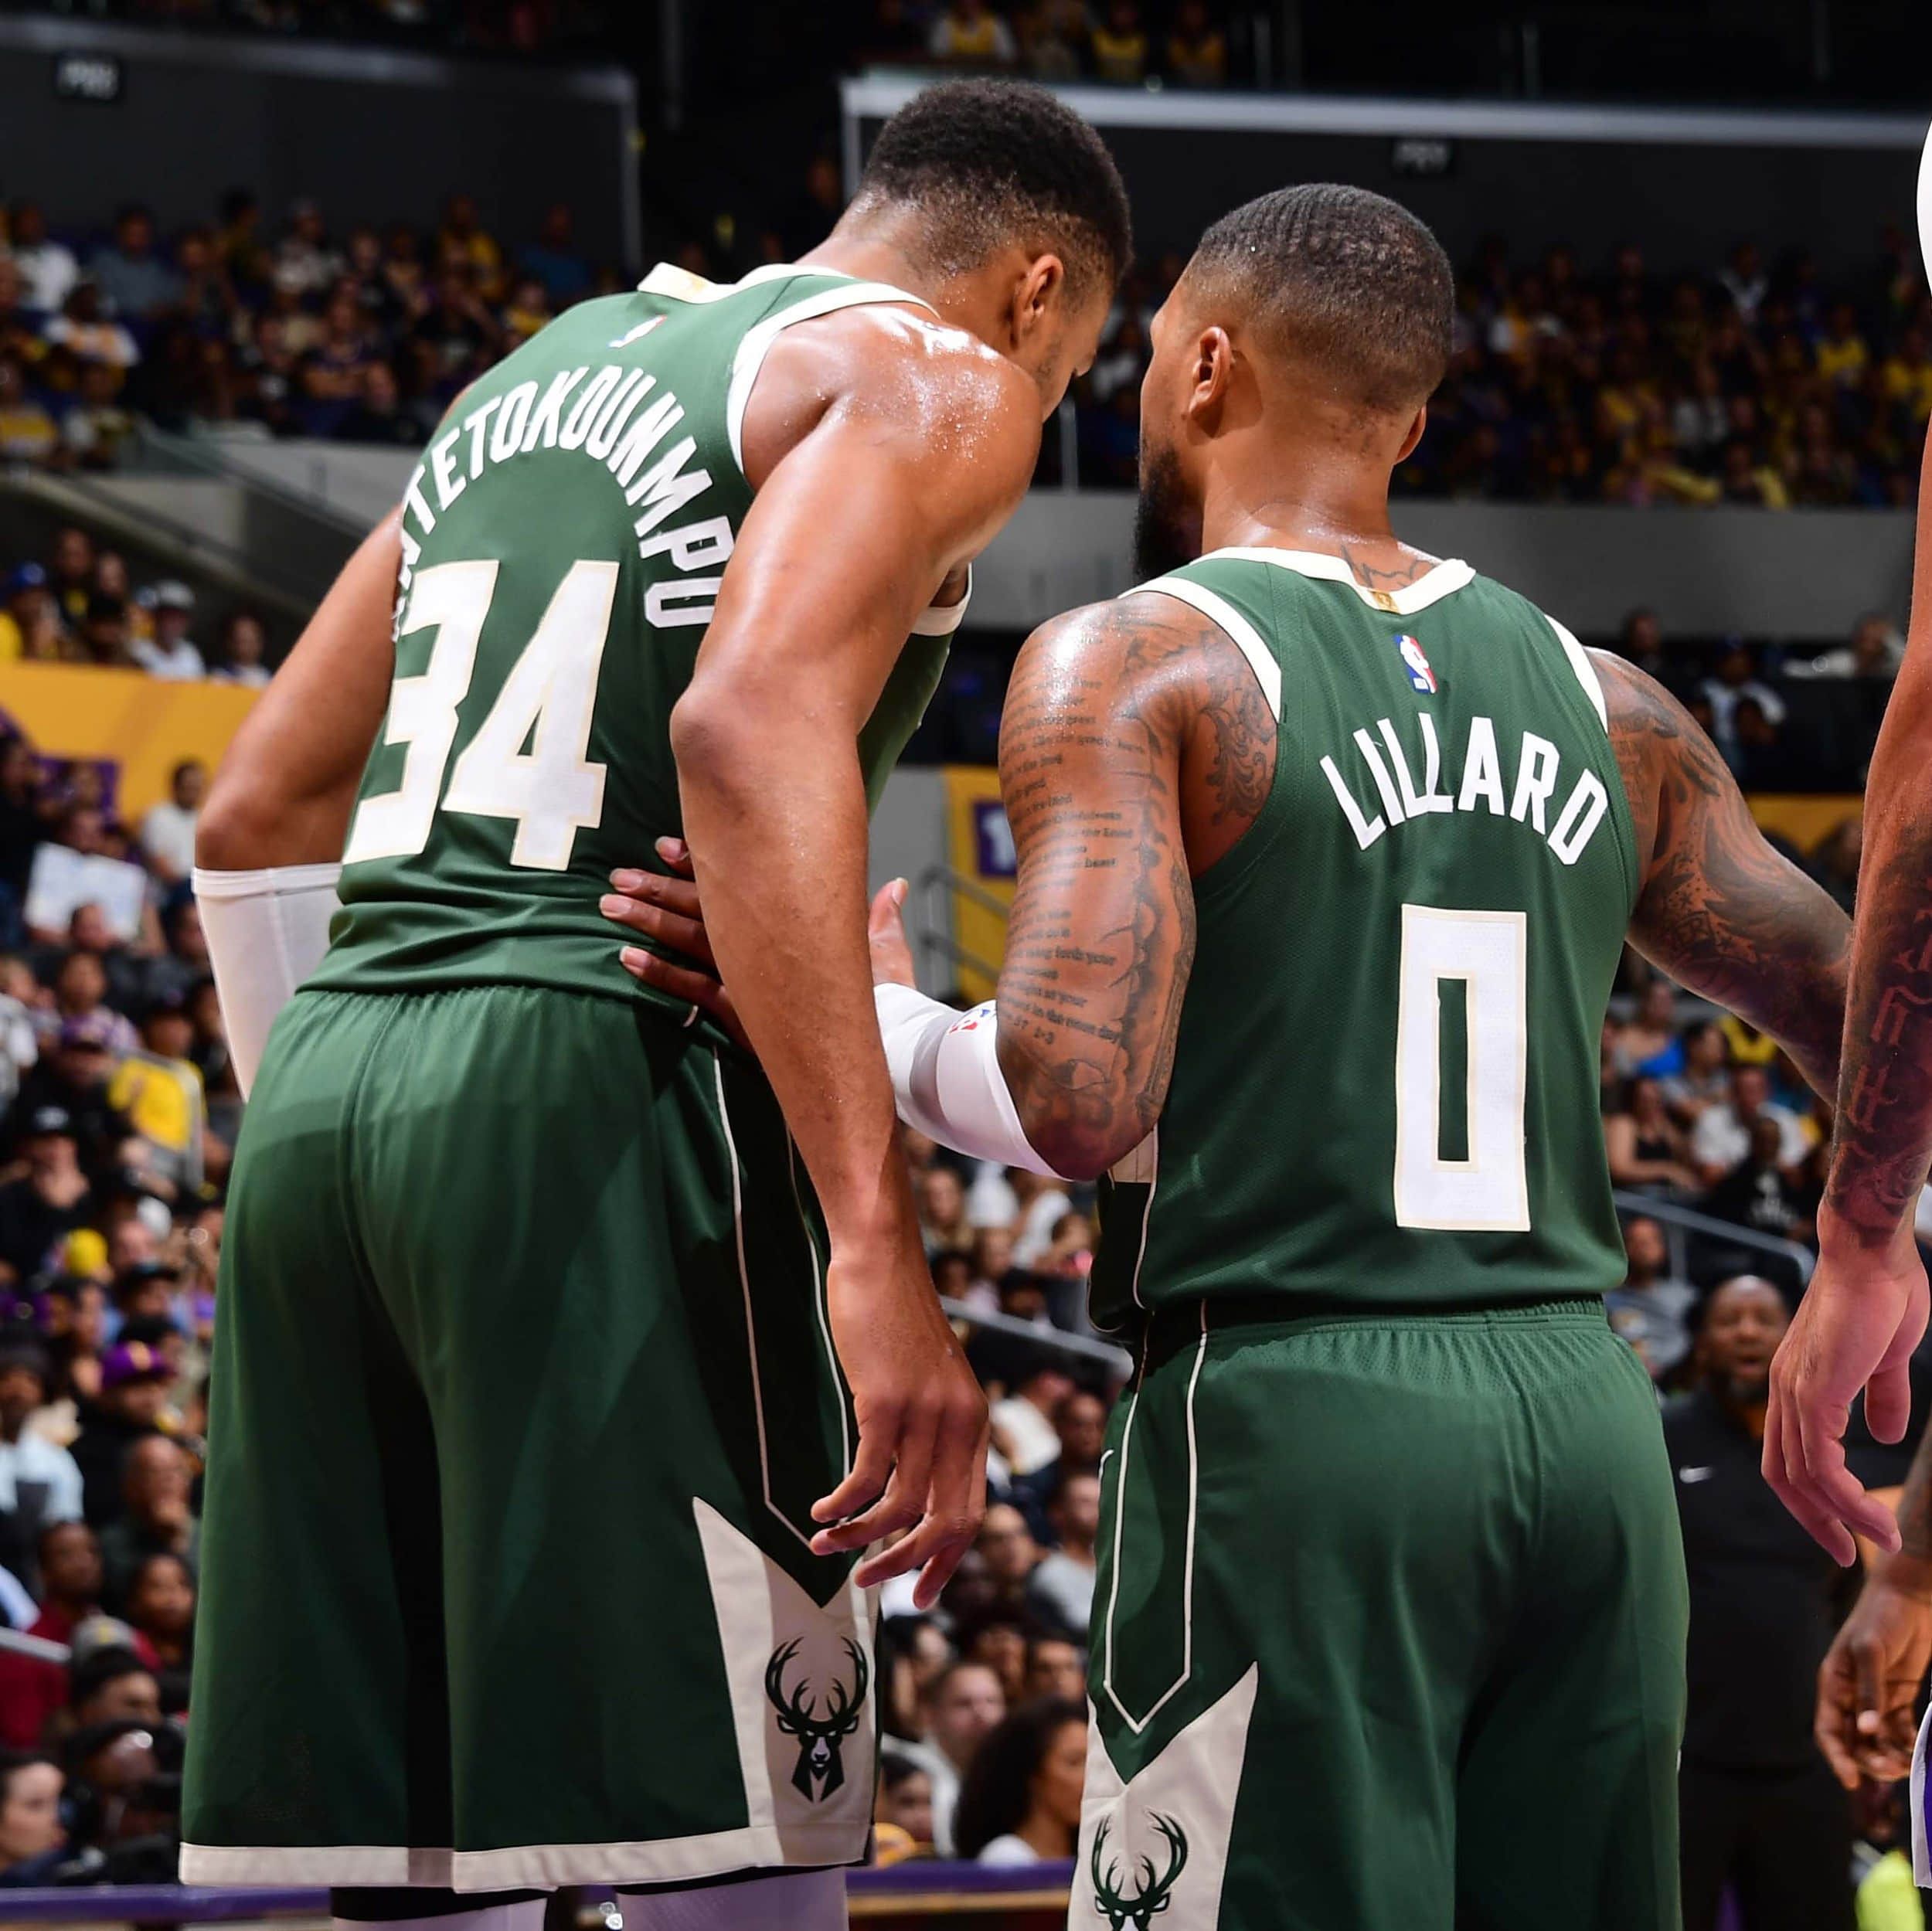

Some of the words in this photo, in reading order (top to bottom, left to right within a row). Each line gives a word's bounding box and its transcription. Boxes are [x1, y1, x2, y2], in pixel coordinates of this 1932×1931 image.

[393, 365, 735, 642] TETOKOUNMPO
[342, 559, 620, 872] 34
[1319, 712, 1609, 865] LILLARD
[1393, 903, 1531, 1232] 0
